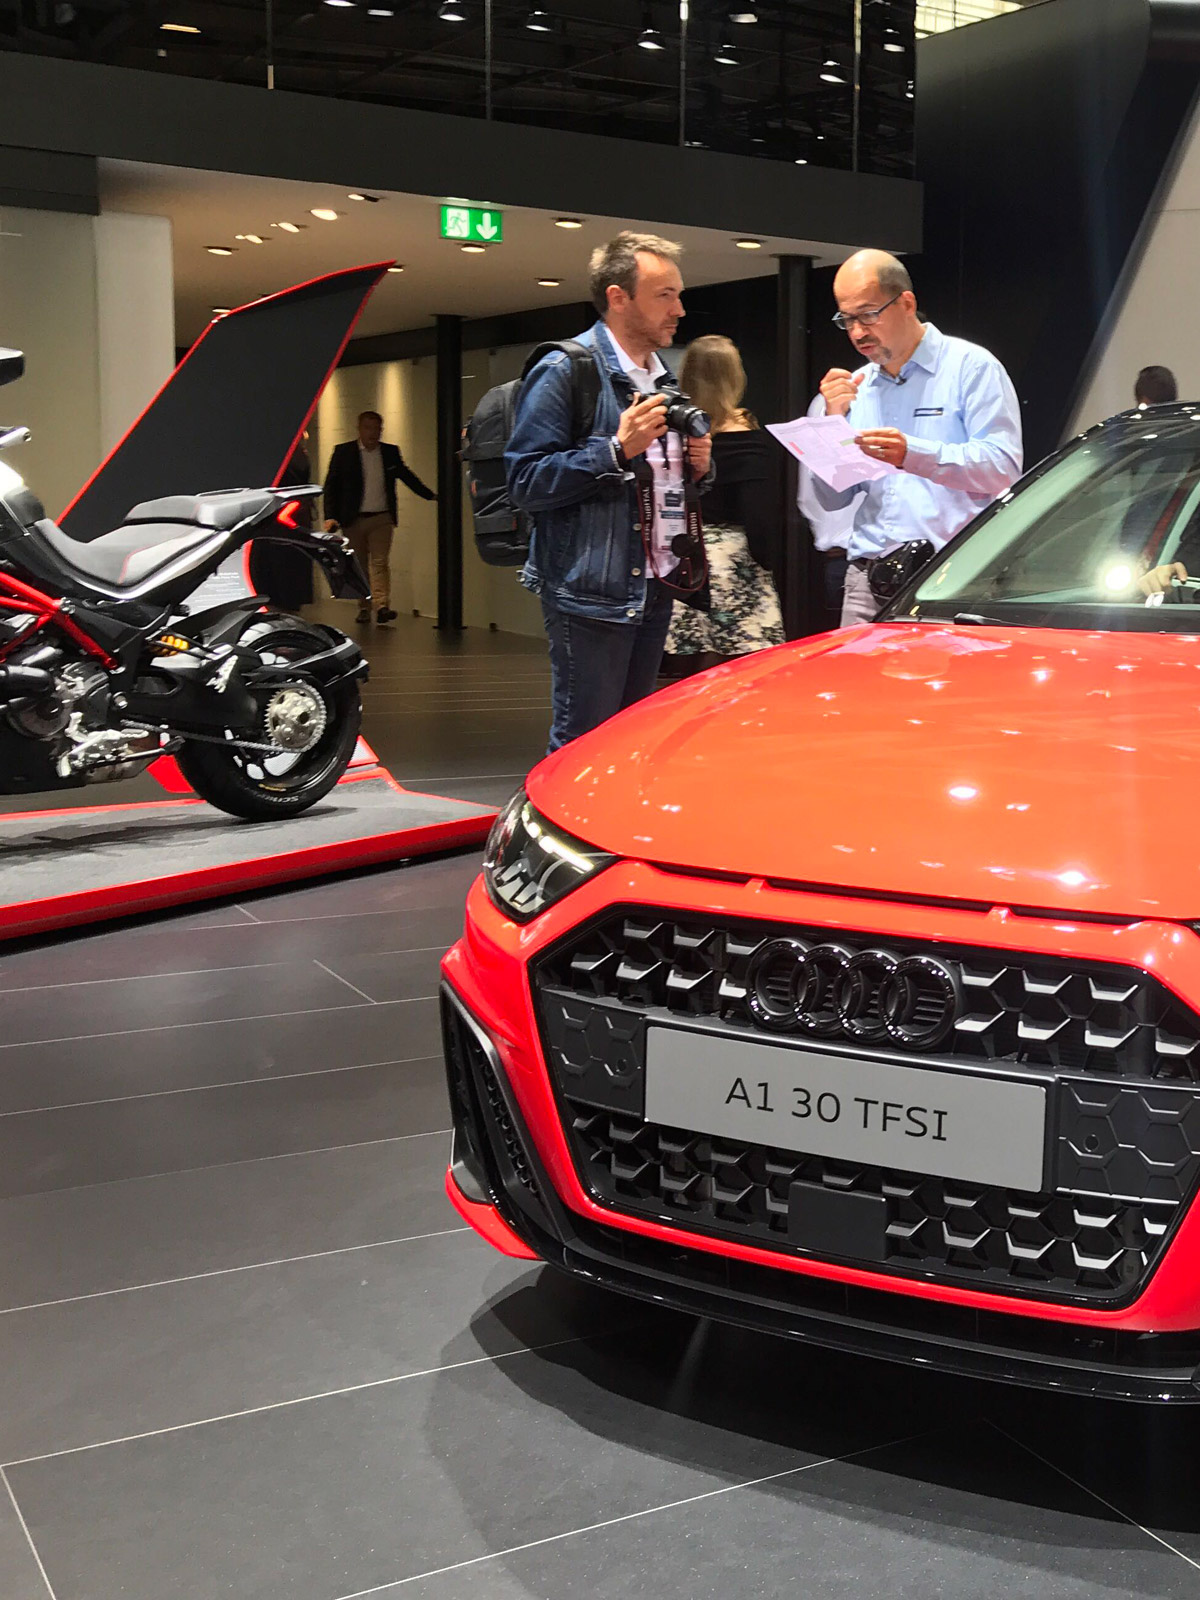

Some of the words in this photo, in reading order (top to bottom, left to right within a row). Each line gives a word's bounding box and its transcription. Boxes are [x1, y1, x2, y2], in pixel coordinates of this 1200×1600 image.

[642, 486, 652, 521] DIGITAL
[725, 1077, 774, 1113] A1
[791, 1087, 841, 1123] 30
[853, 1097, 948, 1142] TFSI
